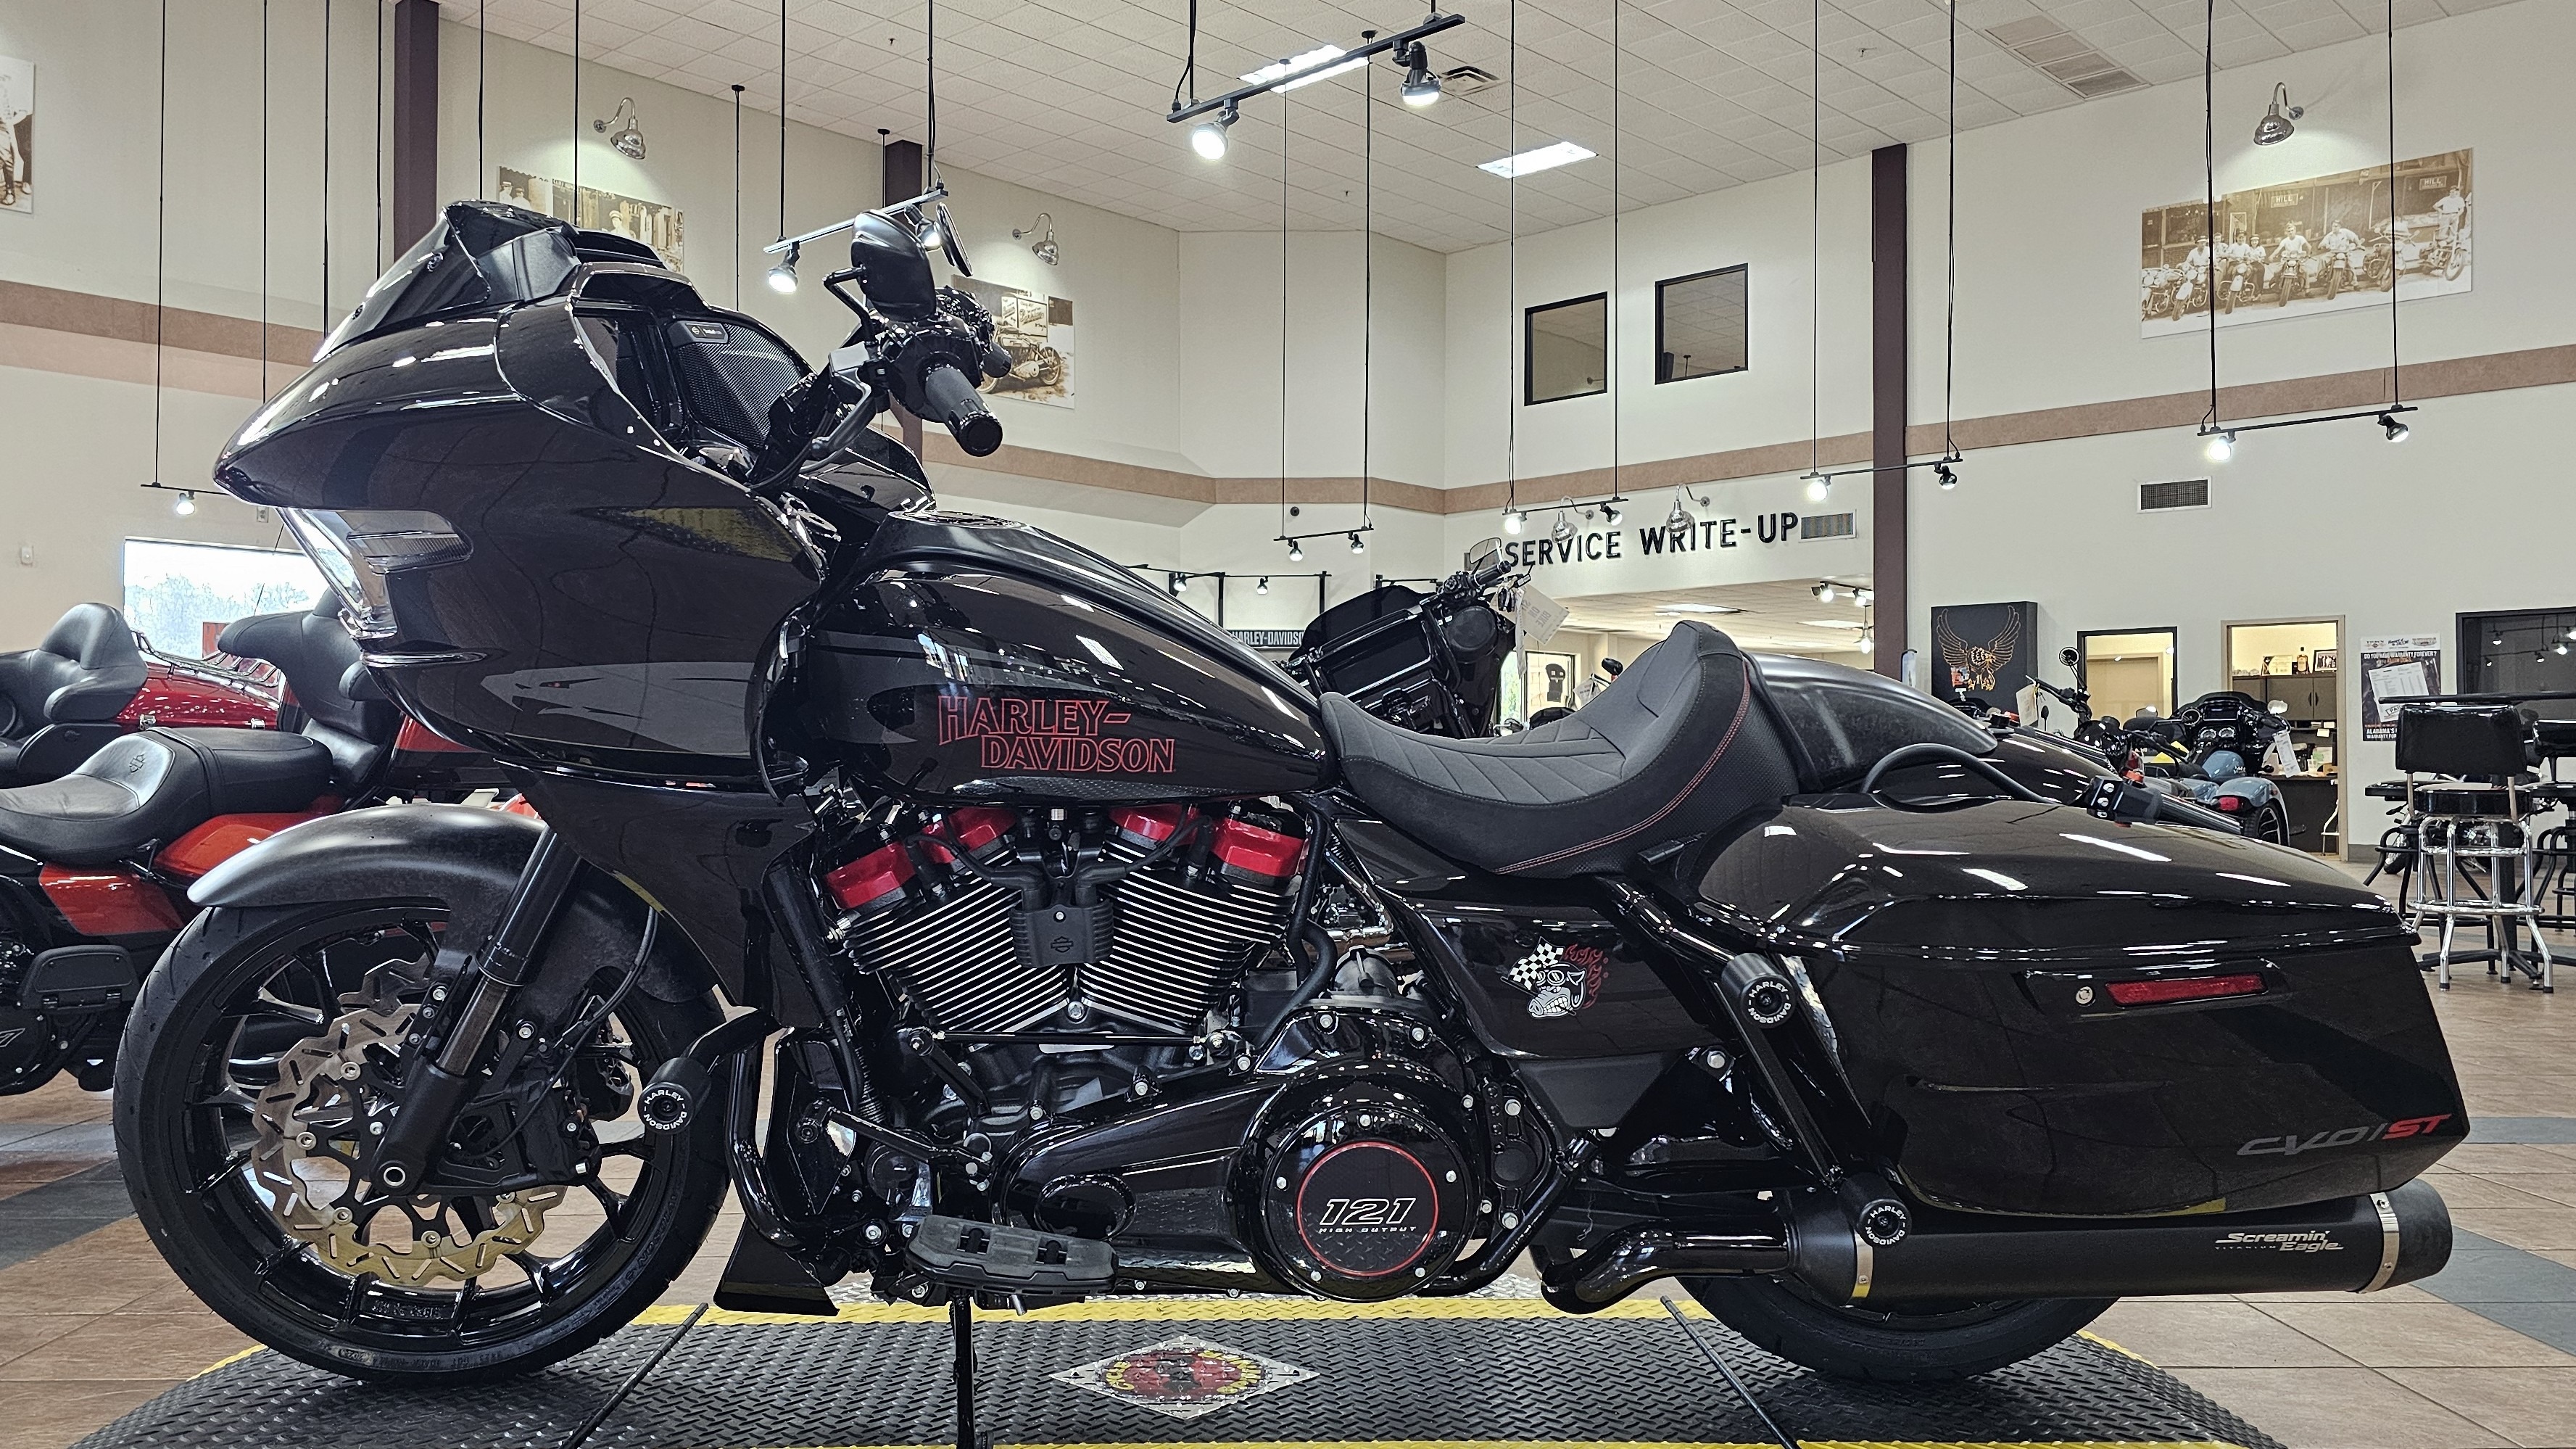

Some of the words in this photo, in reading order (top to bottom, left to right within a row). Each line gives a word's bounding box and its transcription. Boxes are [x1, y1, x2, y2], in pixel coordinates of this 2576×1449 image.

[1506, 531, 1621, 566] SERVICE
[1639, 512, 1799, 556] WRITE-UP
[938, 695, 1131, 746] HARLEY-
[982, 735, 1175, 772] DAVIDSON
[1320, 1198, 1416, 1225] 121
[2215, 1231, 2331, 1244] Screamin'
[2279, 1239, 2344, 1253] Eagle
